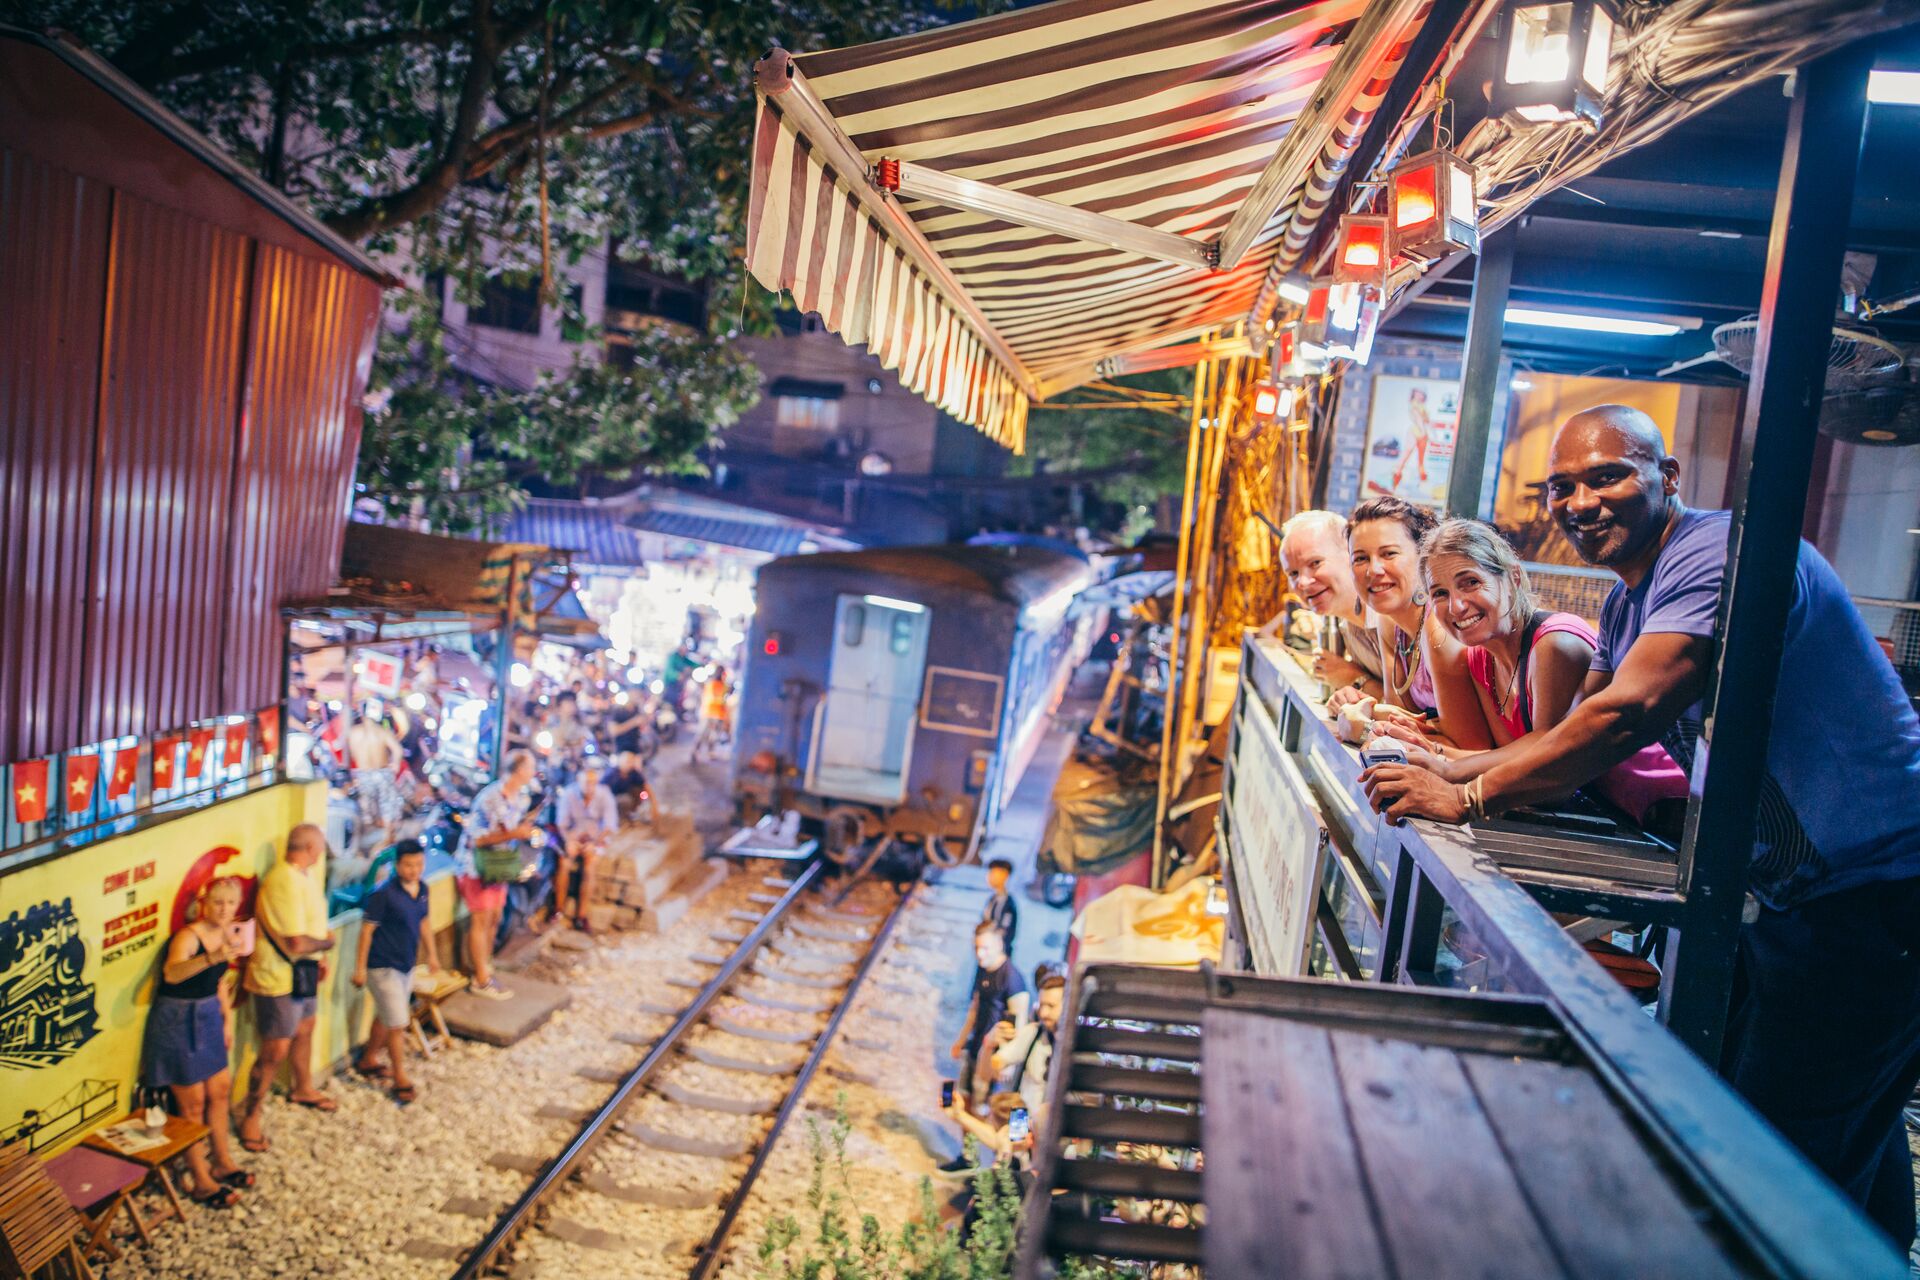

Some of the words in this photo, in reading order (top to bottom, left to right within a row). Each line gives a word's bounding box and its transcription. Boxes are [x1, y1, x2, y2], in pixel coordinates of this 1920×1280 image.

[103, 869, 129, 894] COME
[133, 861, 156, 883] BACK
[104, 902, 158, 933] VIETNAM
[103, 918, 158, 949] RAILROAD
[101, 934, 155, 966] HISTORY
